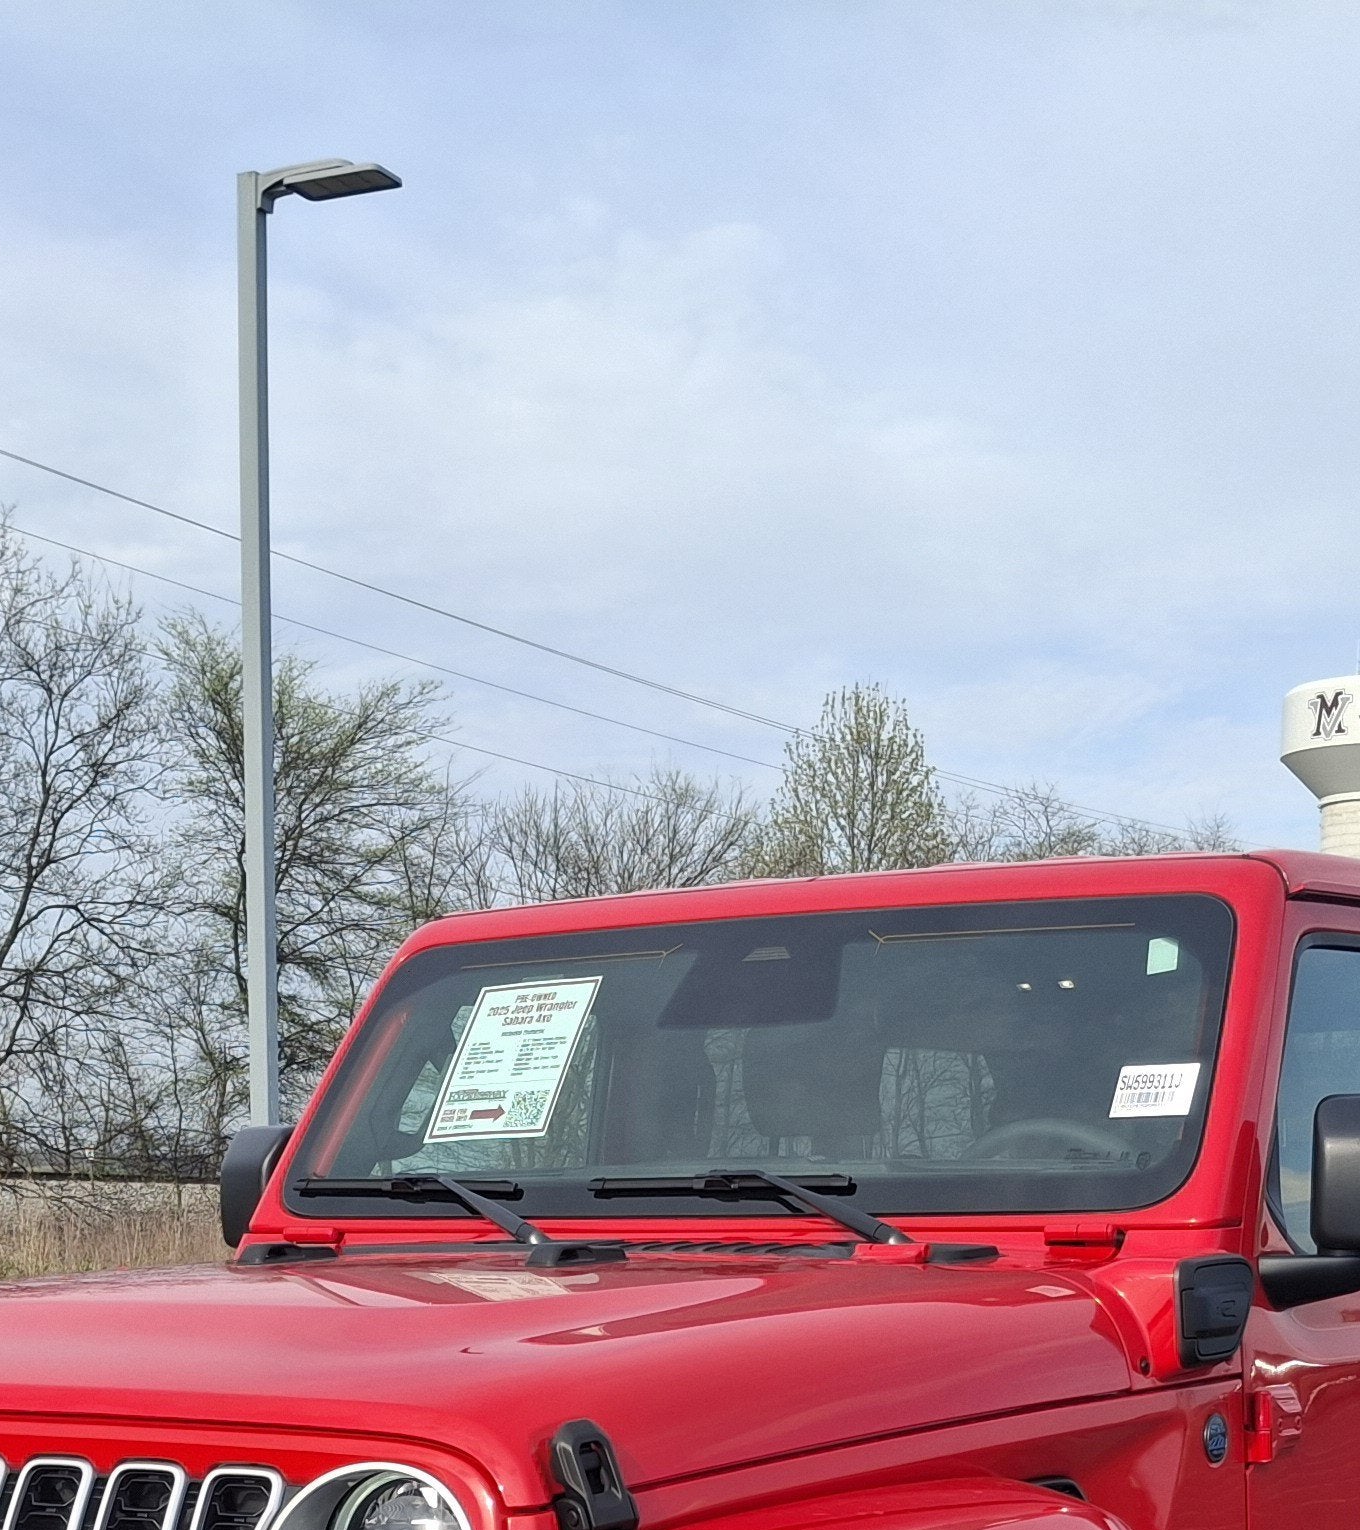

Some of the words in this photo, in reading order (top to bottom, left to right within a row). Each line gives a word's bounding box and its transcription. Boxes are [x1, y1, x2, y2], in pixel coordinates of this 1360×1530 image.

[487, 1005, 510, 1017] 2025
[511, 1004, 534, 1015] Jeep
[536, 1000, 578, 1012] Wrangler
[502, 1015, 534, 1026] Sahara
[1120, 1073, 1183, 1091] SW599311J
